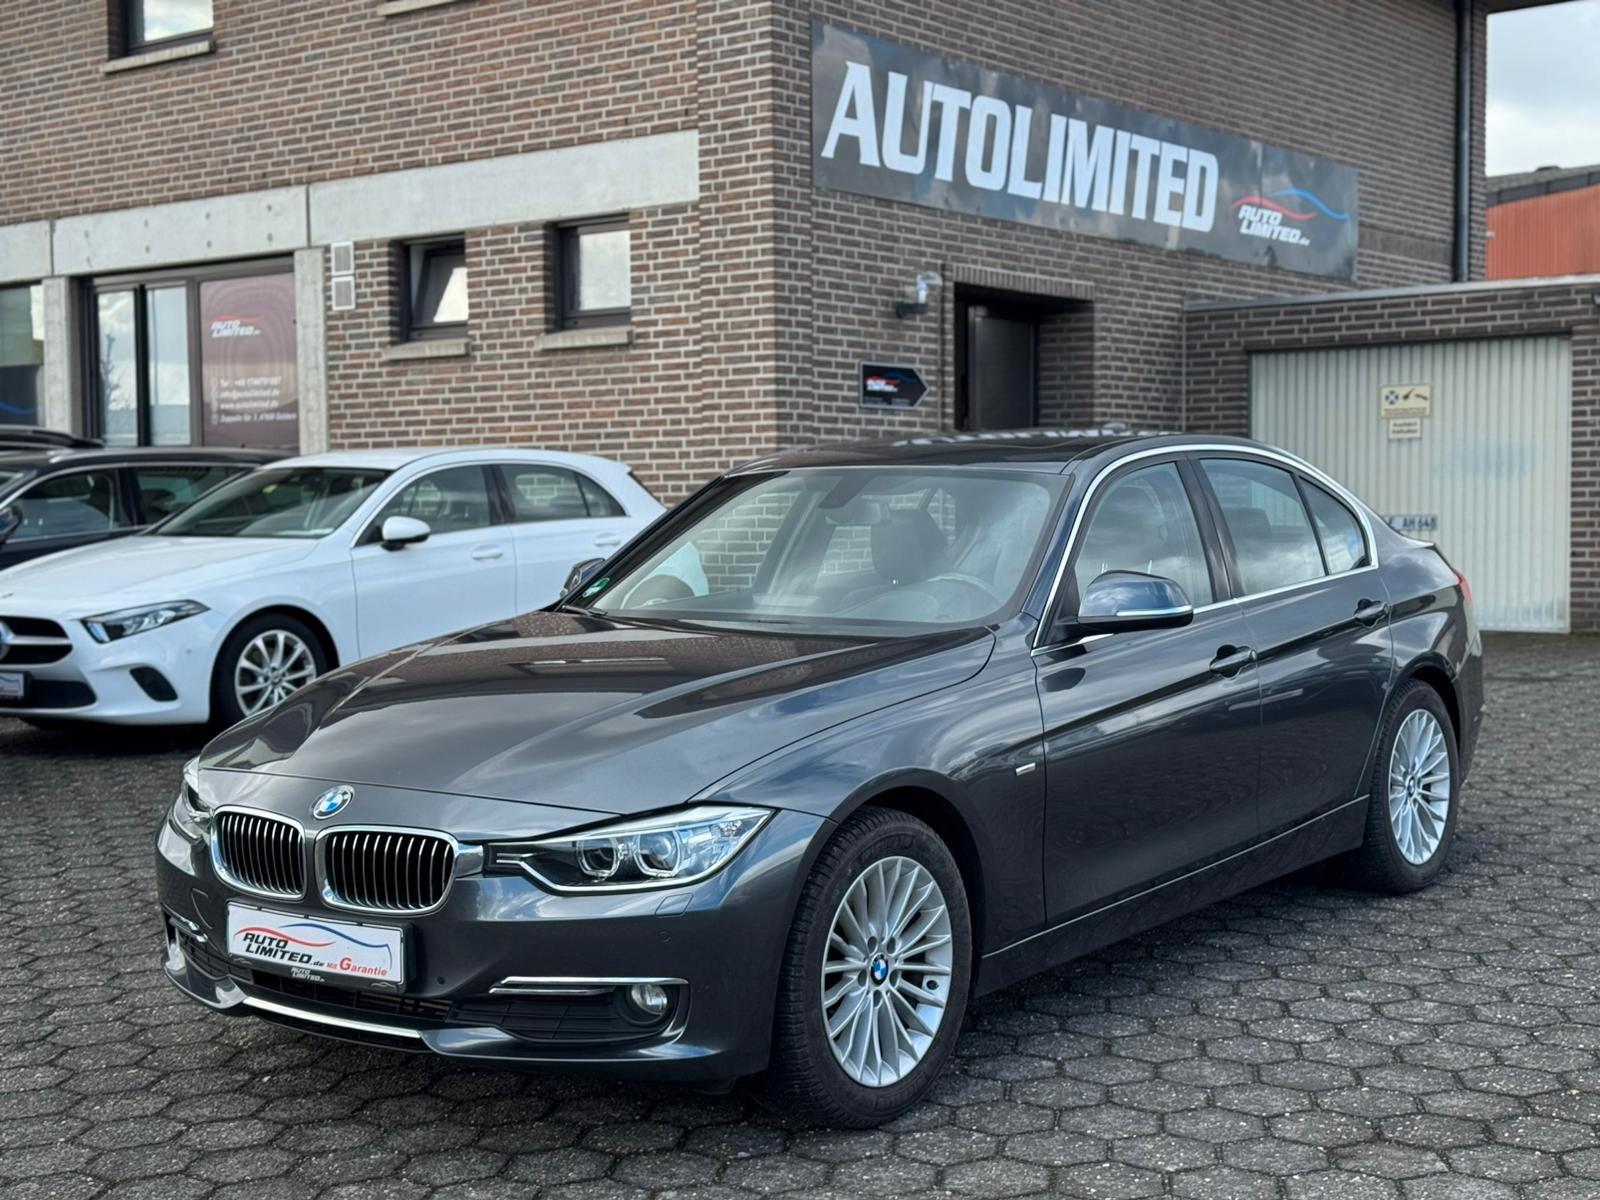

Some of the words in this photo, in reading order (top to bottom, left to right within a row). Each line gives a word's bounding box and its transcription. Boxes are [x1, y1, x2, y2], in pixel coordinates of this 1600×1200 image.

[820, 60, 1219, 233] AUTOLIMITED
[1238, 204, 1283, 226] AUTO
[243, 933, 289, 949] AUTO
[339, 956, 388, 977] Garantie
